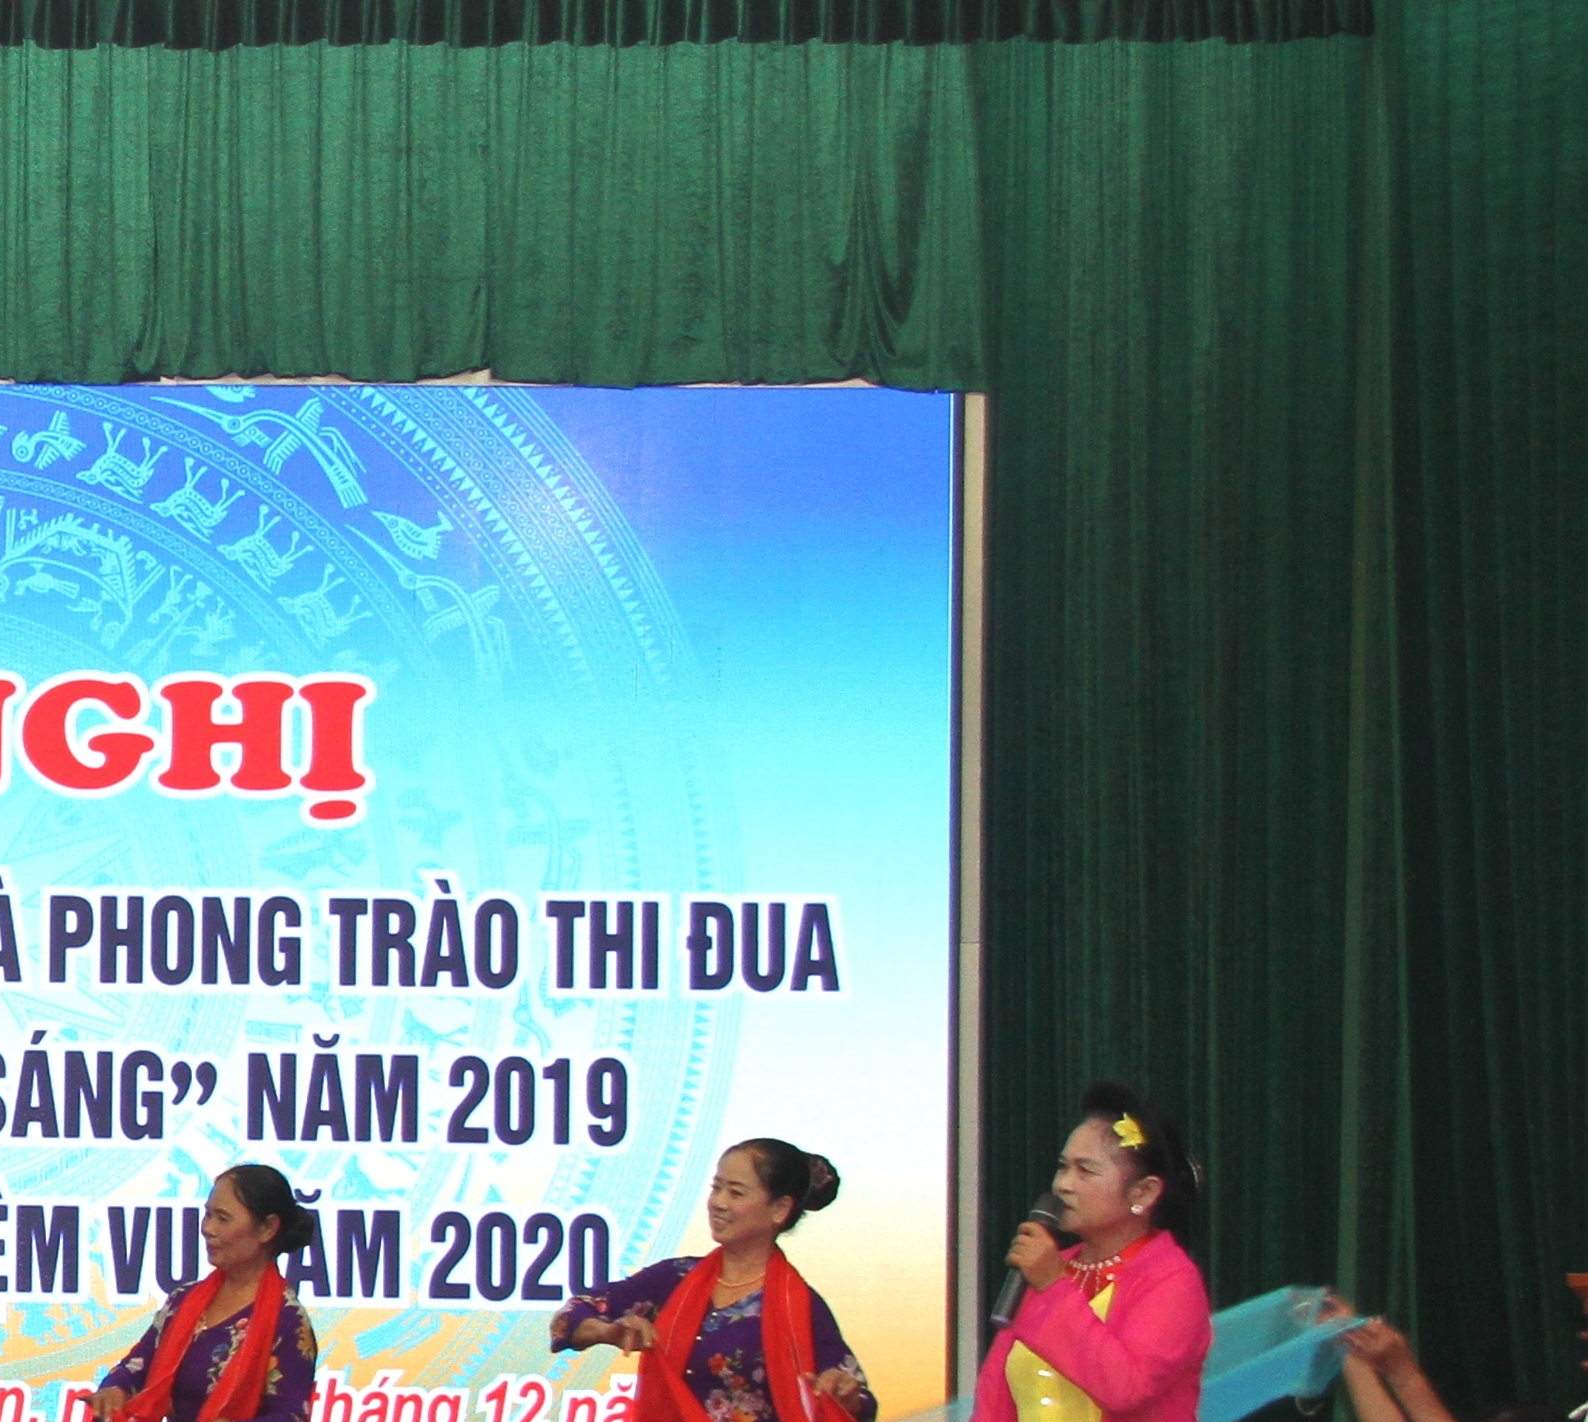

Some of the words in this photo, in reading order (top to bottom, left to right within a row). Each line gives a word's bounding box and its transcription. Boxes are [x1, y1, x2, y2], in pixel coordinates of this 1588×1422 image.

[49, 894, 303, 987] PHONG
[328, 878, 520, 991] TRÀO
[546, 901, 660, 991] THI
[686, 902, 840, 993] ĐUA
[246, 1033, 420, 1143] NĂM
[446, 1056, 627, 1148] 2019
[285, 1188, 402, 1299] ĂM
[429, 1210, 611, 1302] 2020
